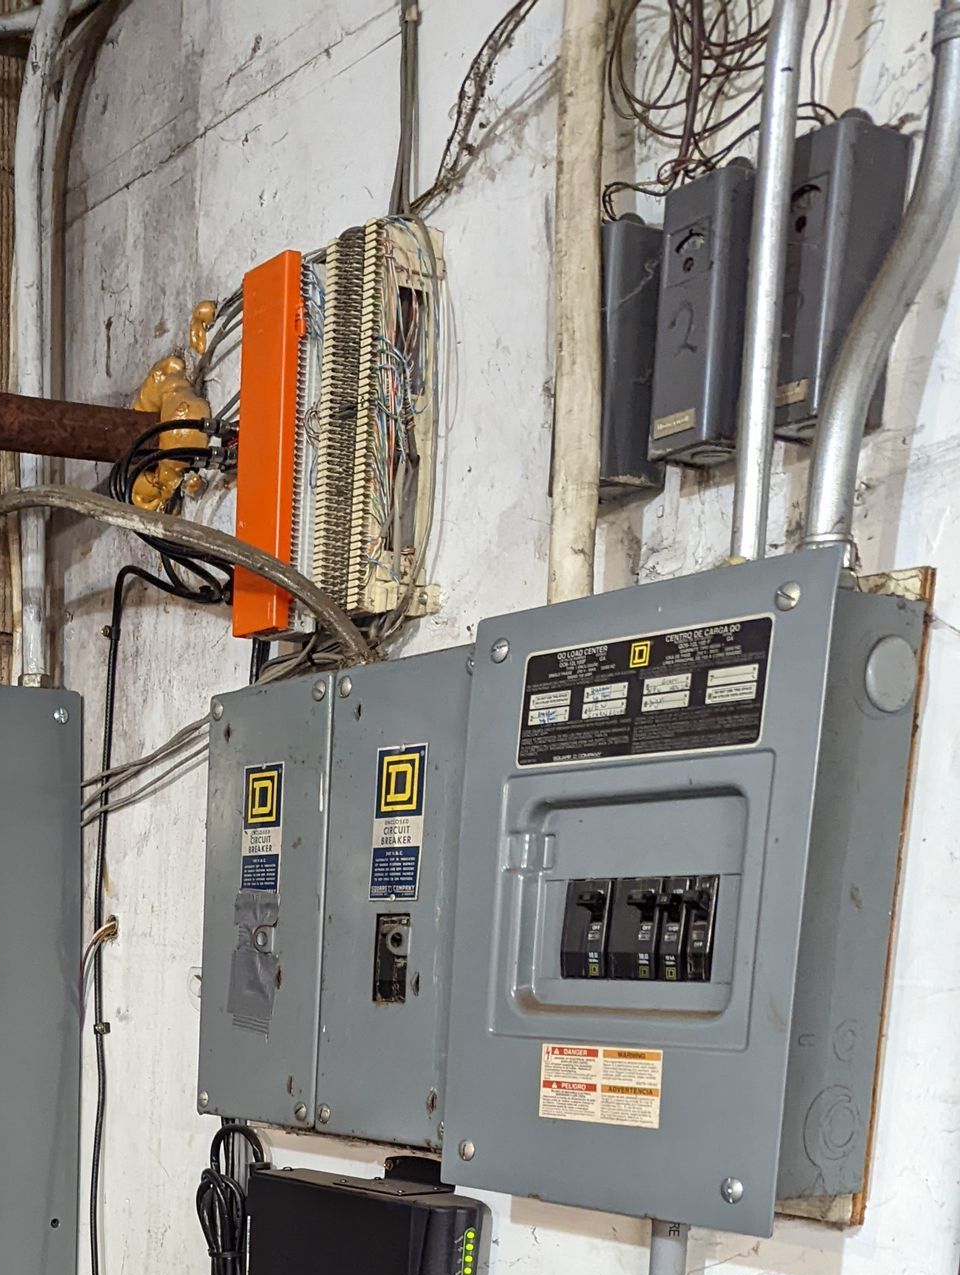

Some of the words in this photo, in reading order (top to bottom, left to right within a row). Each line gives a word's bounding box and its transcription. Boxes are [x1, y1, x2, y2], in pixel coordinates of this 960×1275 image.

[665, 632, 693, 643] CENTRO
[693, 630, 704, 638] DE
[704, 626, 728, 637] CARGA
[567, 649, 584, 659] LOAD
[583, 645, 608, 656] CENTER
[385, 761, 415, 806] D
[250, 777, 274, 818] D
[383, 826, 411, 836] CIRCUIT
[250, 836, 272, 845] CIRCUIT
[380, 835, 412, 846] BREAKER
[248, 845, 273, 854] BREAKER
[563, 1047, 588, 1056] DANGER
[617, 1051, 646, 1059] WARNING
[561, 1082, 587, 1091] PELIGRO
[608, 1086, 653, 1096] ADVERTENCIA
